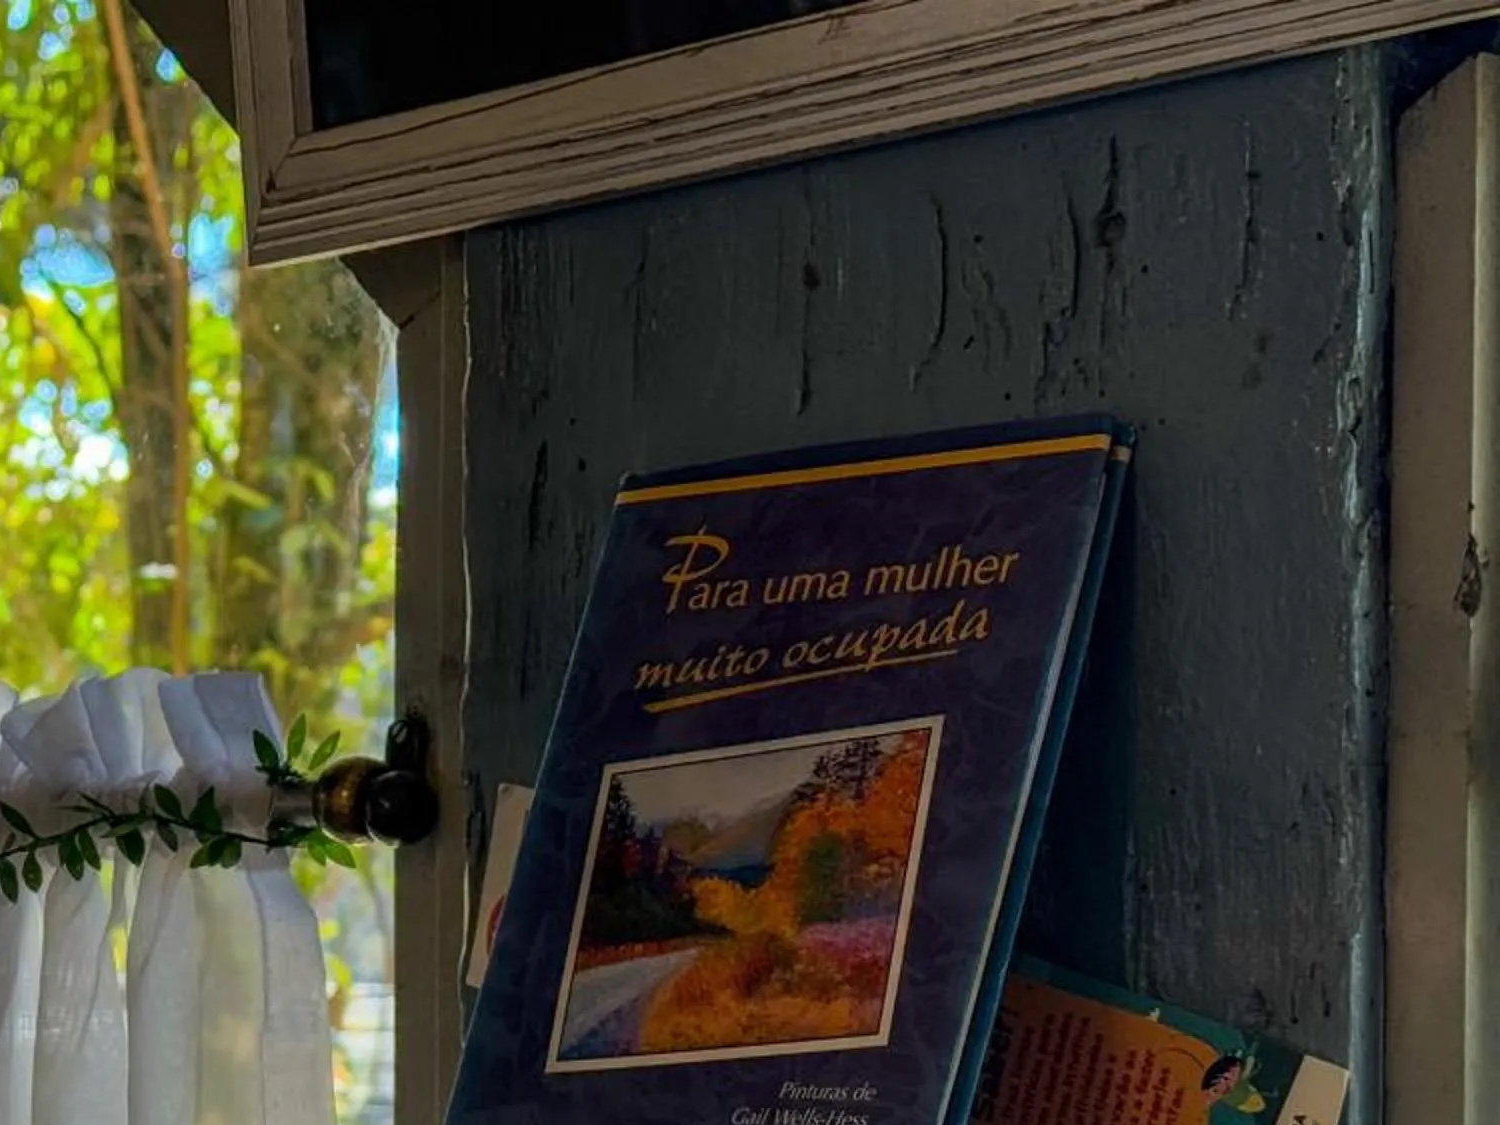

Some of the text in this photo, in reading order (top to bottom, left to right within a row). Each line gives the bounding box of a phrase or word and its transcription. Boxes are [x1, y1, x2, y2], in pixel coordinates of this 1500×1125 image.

[662, 524, 1020, 614] Para uma mulher
[634, 600, 991, 690] muito ocupada
[778, 1081, 879, 1101] Pinturas de
